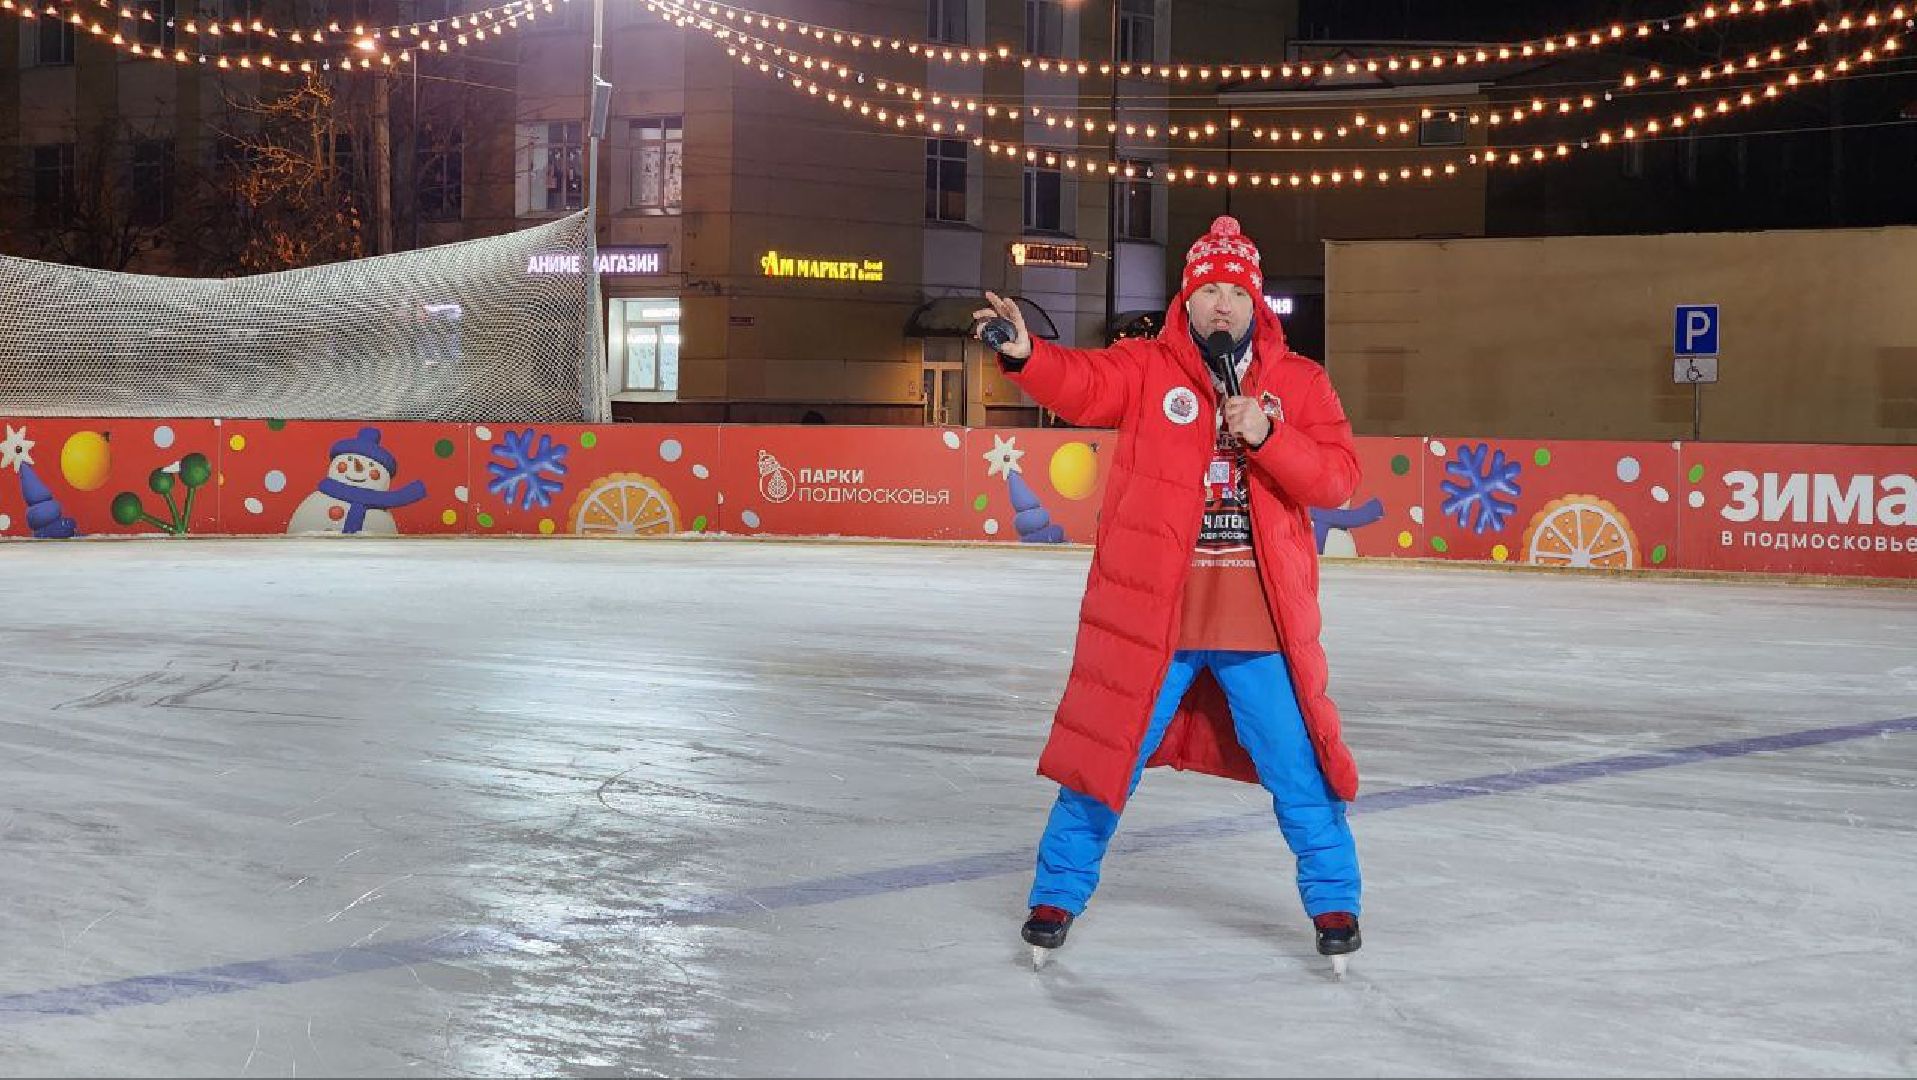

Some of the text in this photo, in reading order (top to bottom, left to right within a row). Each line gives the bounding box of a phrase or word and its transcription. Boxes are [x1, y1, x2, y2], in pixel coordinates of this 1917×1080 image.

[527, 254, 580, 273] АНИМЕ
[797, 259, 859, 280] МАРКЕТ
[1686, 310, 1711, 350] P
[800, 469, 865, 484] ПАРКИ
[798, 487, 950, 504] ПОДМОСКОВЬЯ
